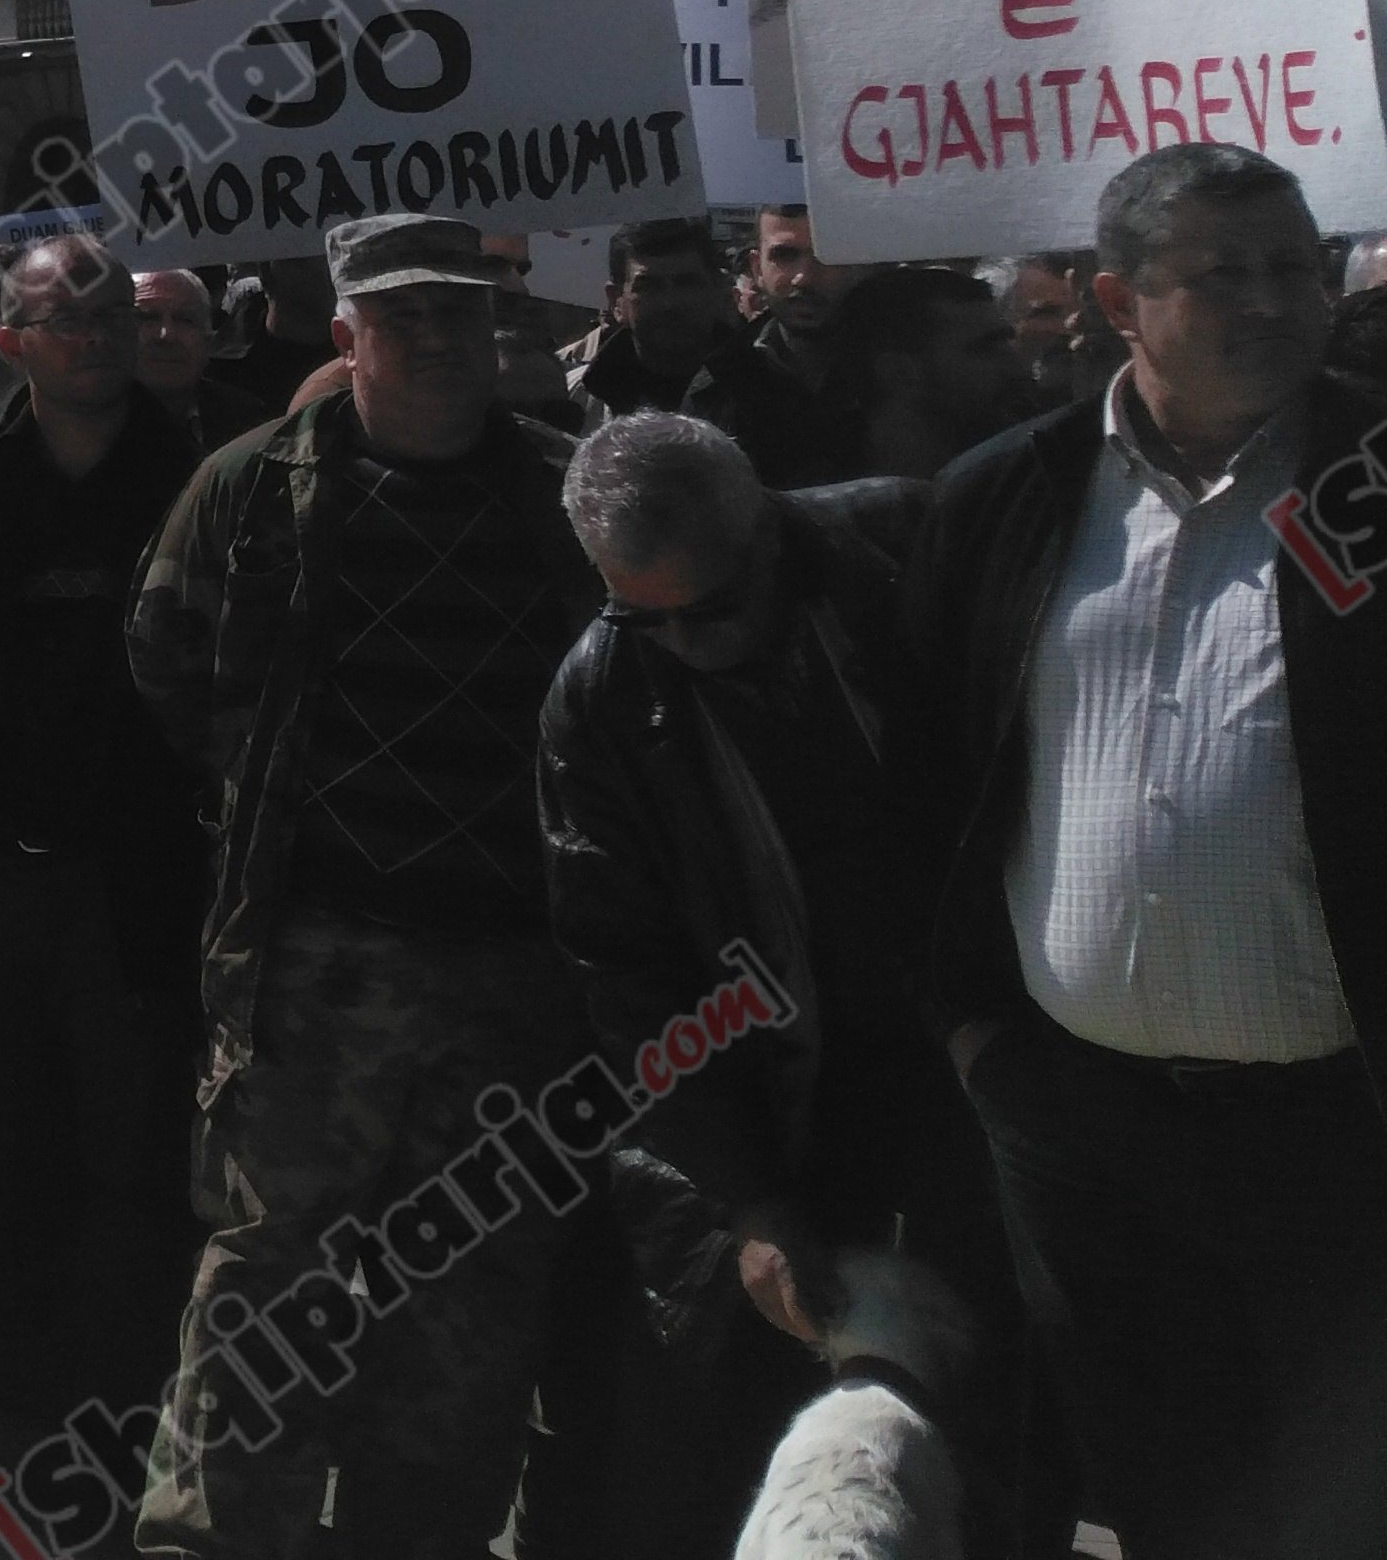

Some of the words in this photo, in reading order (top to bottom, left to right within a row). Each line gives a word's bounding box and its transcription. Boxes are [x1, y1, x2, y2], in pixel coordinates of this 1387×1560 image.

[244, 8, 473, 129] JO
[840, 49, 1344, 189] GJAHTAREVE.
[10, 222, 59, 244] DUAM
[135, 109, 687, 247] MORATORIUMIT
